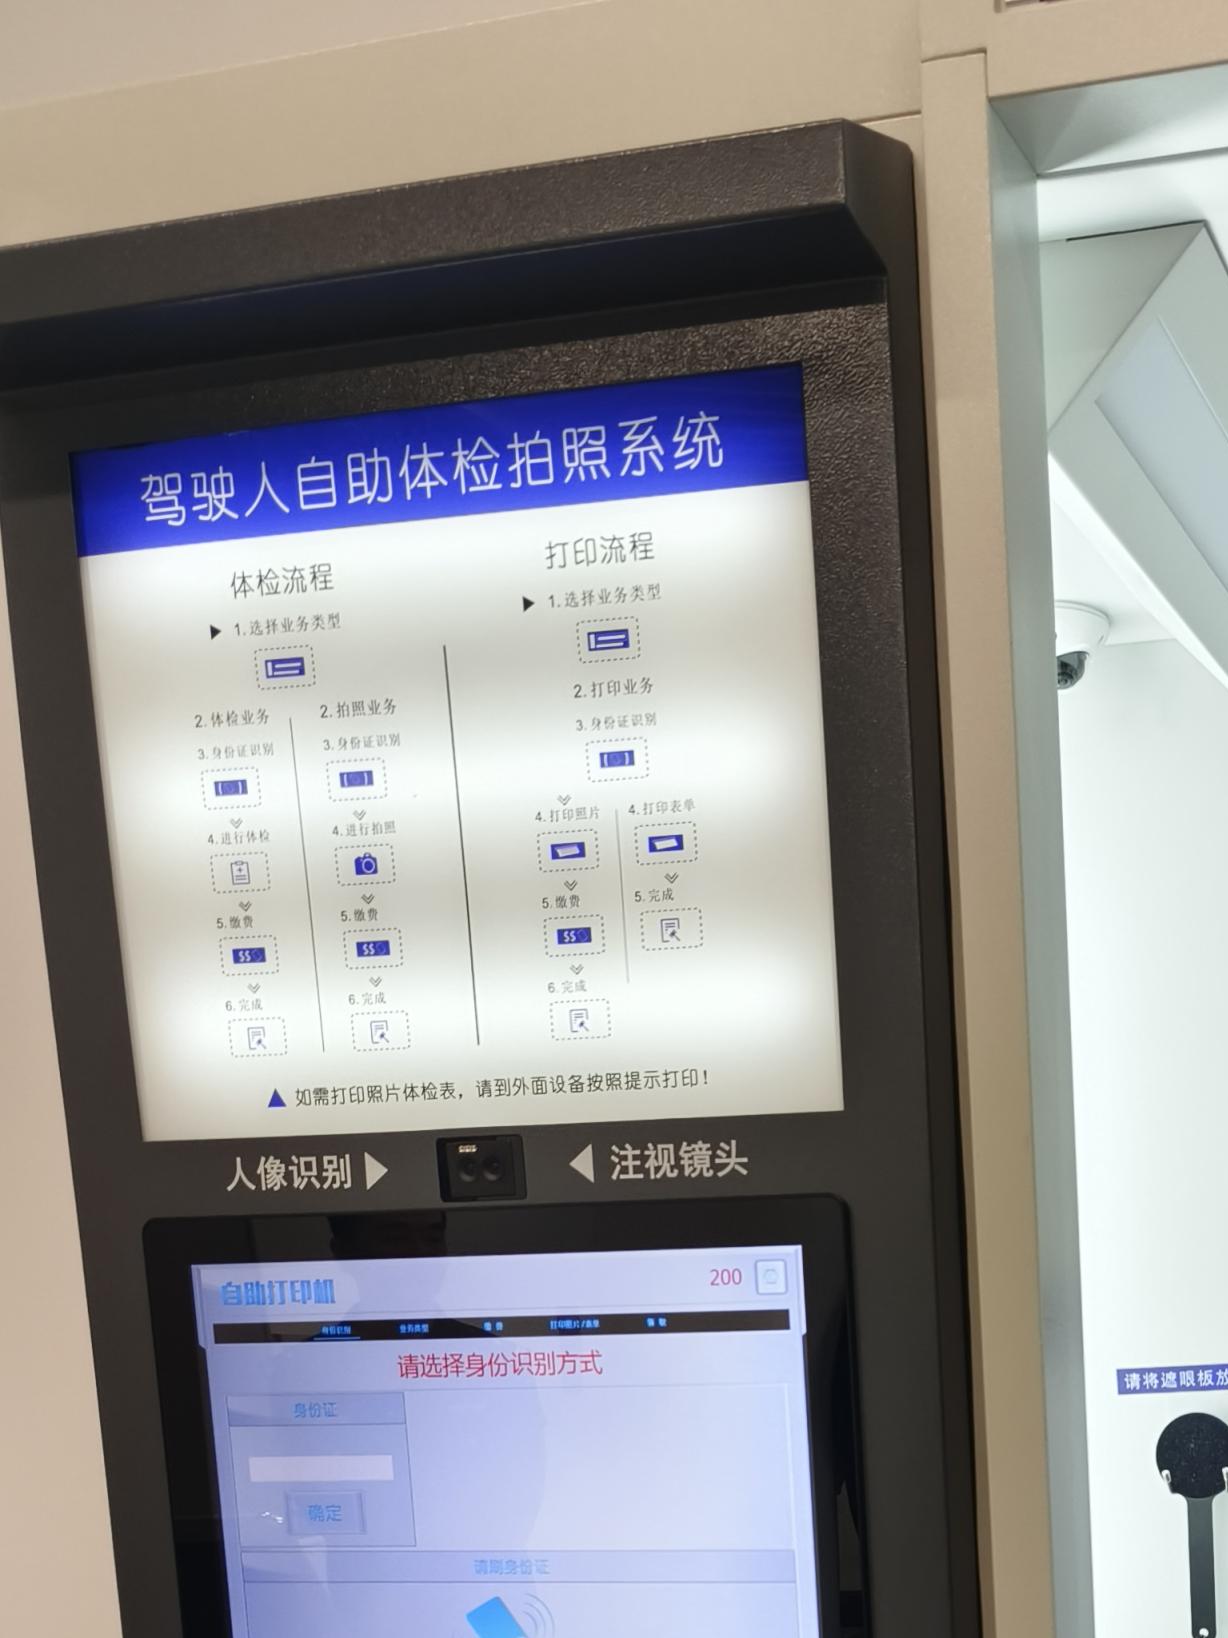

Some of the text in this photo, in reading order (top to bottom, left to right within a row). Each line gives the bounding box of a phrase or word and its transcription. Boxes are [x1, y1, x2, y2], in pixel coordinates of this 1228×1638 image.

[139, 411, 725, 528] 驾驶人自助体检拍照系统
[545, 531, 655, 570] 打印流程
[230, 562, 335, 599] 体检流程
[547, 583, 662, 610] 1.选择业务类型
[234, 612, 342, 638] 1.选择业务类型
[573, 676, 654, 699] 2.打印业务
[194, 708, 270, 729] 2.体检业务
[320, 698, 397, 719] 2.拍照业务
[576, 712, 657, 732] 3.身份证识别
[198, 742, 274, 760] 3.身份证识别
[323, 732, 401, 751] 3.身份证识别
[535, 806, 600, 823] 4.打印照片
[628, 798, 696, 816] 4.打印表单
[207, 829, 271, 846] 4.进行体检
[332, 820, 396, 837] 4.进行拍照
[542, 895, 580, 909] 5.缴费
[634, 887, 675, 903] 5.完成
[216, 915, 254, 930] 5.缴费
[340, 907, 379, 922] 5.缴费
[548, 979, 588, 994] 6.完成
[225, 998, 264, 1012] 6.完成
[348, 992, 386, 1006] 6.完成
[610, 1140, 749, 1182] 注视镜头
[226, 1153, 352, 1192] 人像识别
[709, 1268, 743, 1287] 200
[221, 1278, 336, 1307] 自助打印机
[397, 1349, 604, 1381] 请选择身份识别方式
[293, 1401, 339, 1421] 身份证
[307, 1503, 342, 1523] 确定
